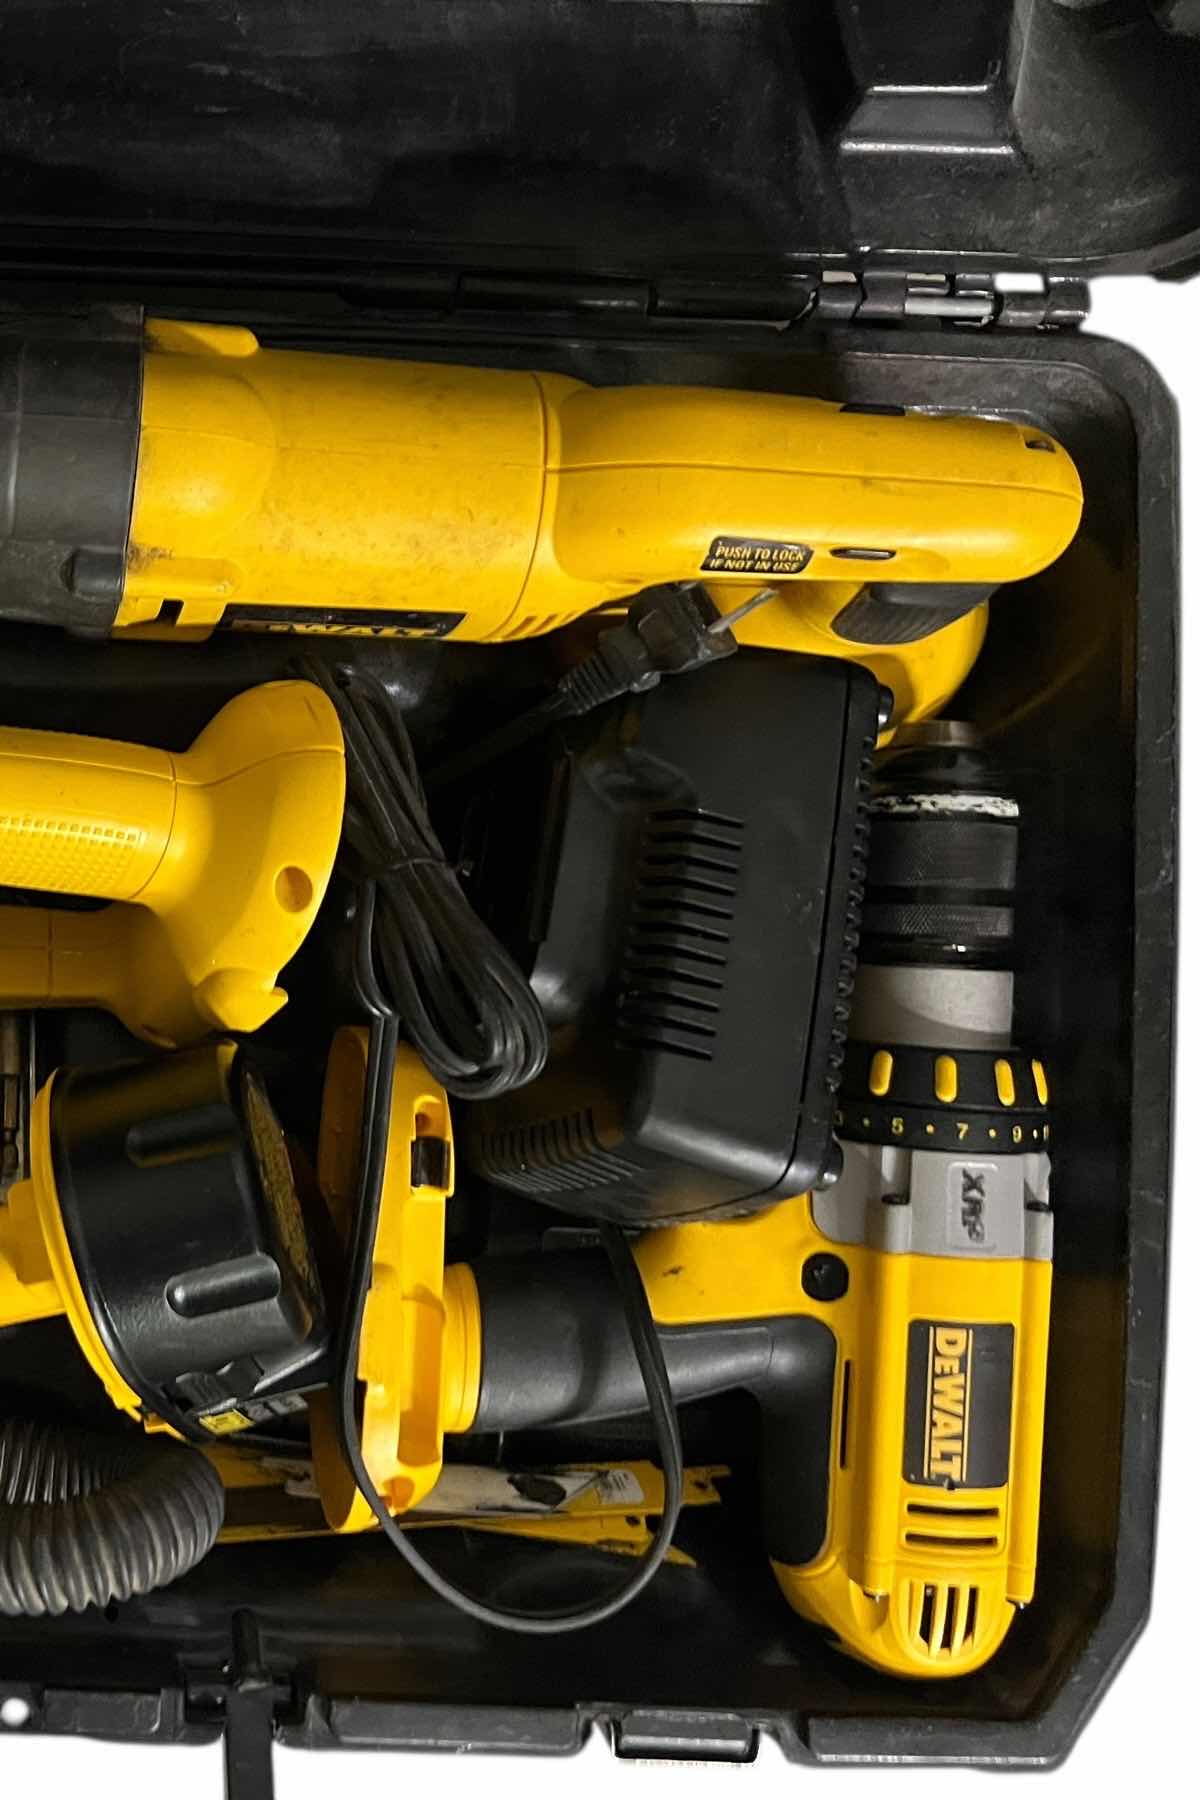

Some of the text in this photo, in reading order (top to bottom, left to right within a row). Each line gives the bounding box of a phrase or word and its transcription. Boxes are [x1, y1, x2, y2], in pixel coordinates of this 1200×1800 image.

[716, 545, 805, 561] PUSH TO LOCK
[710, 559, 800, 571] IF NOT IN USE
[891, 1117, 904, 1135] 5
[956, 1122, 969, 1140] 7
[1012, 1125, 1023, 1144] 9
